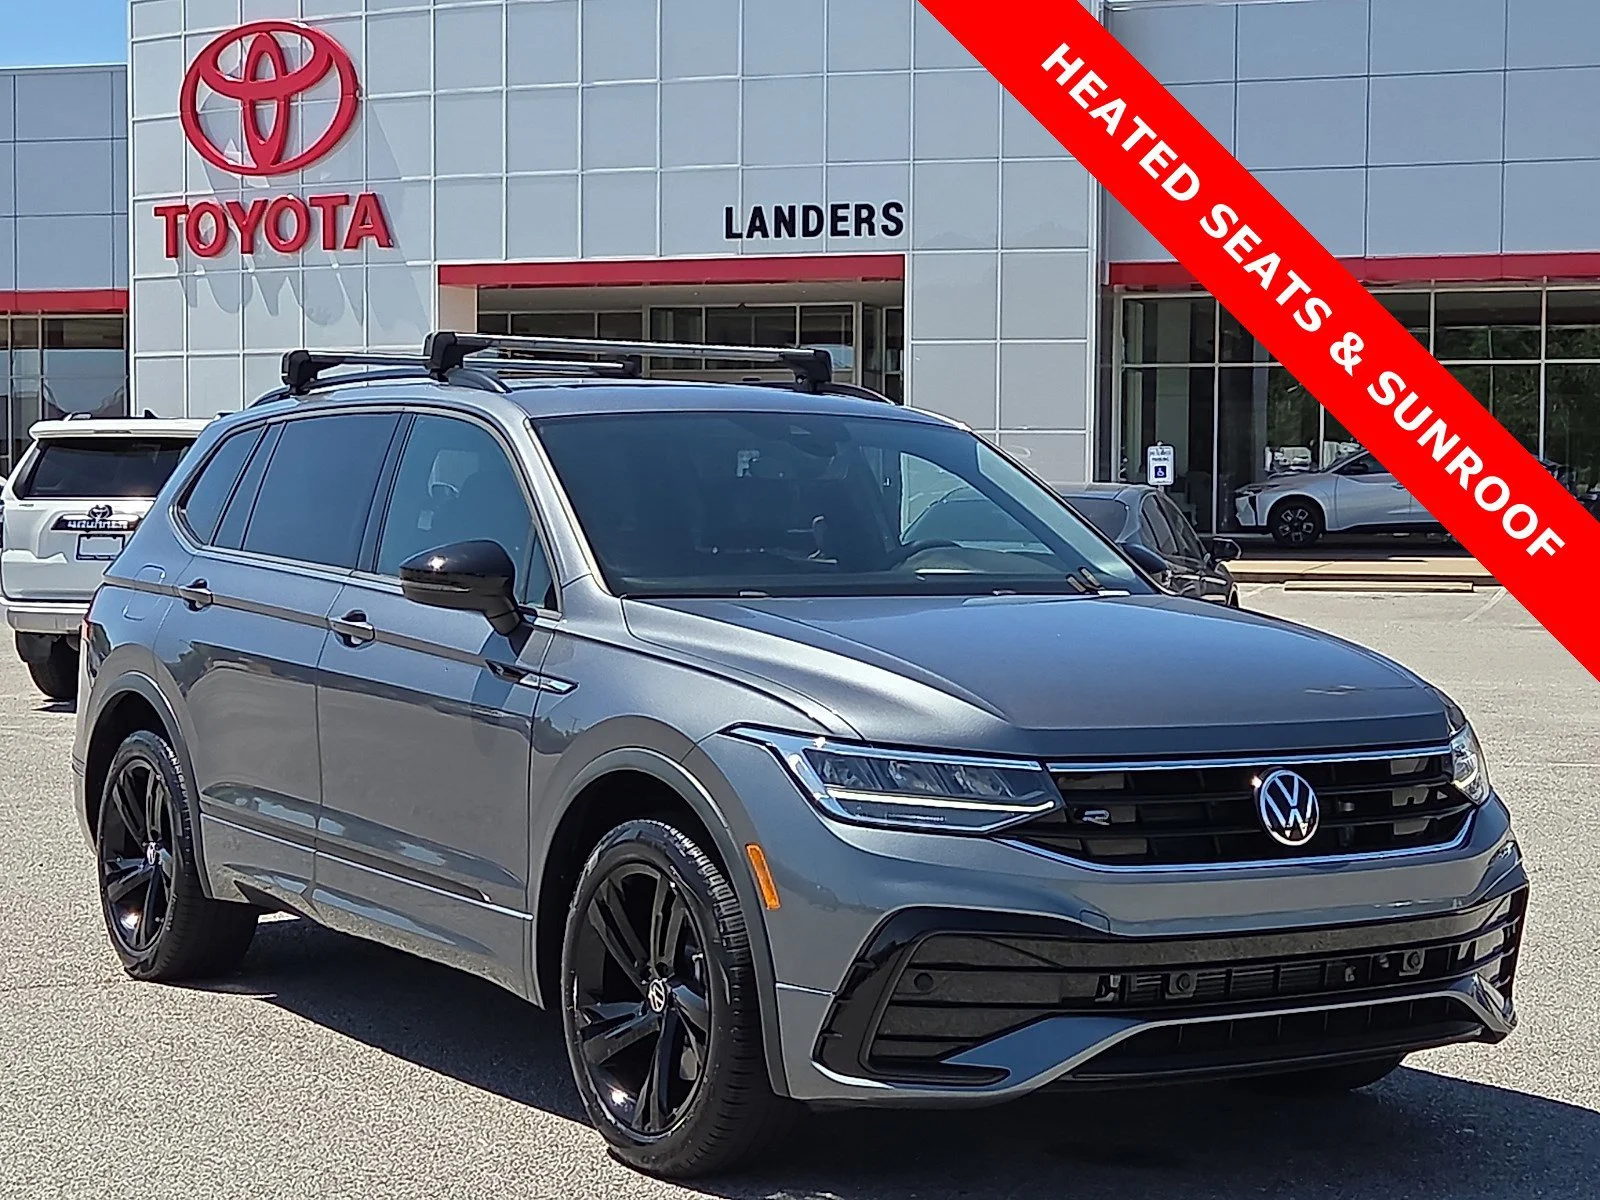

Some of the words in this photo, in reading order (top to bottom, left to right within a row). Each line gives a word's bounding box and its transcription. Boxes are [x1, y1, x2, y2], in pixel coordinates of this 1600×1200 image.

[155, 192, 393, 258] TOYOTA
[724, 201, 904, 240] LANDERS
[1260, 769, 1319, 846] VW
